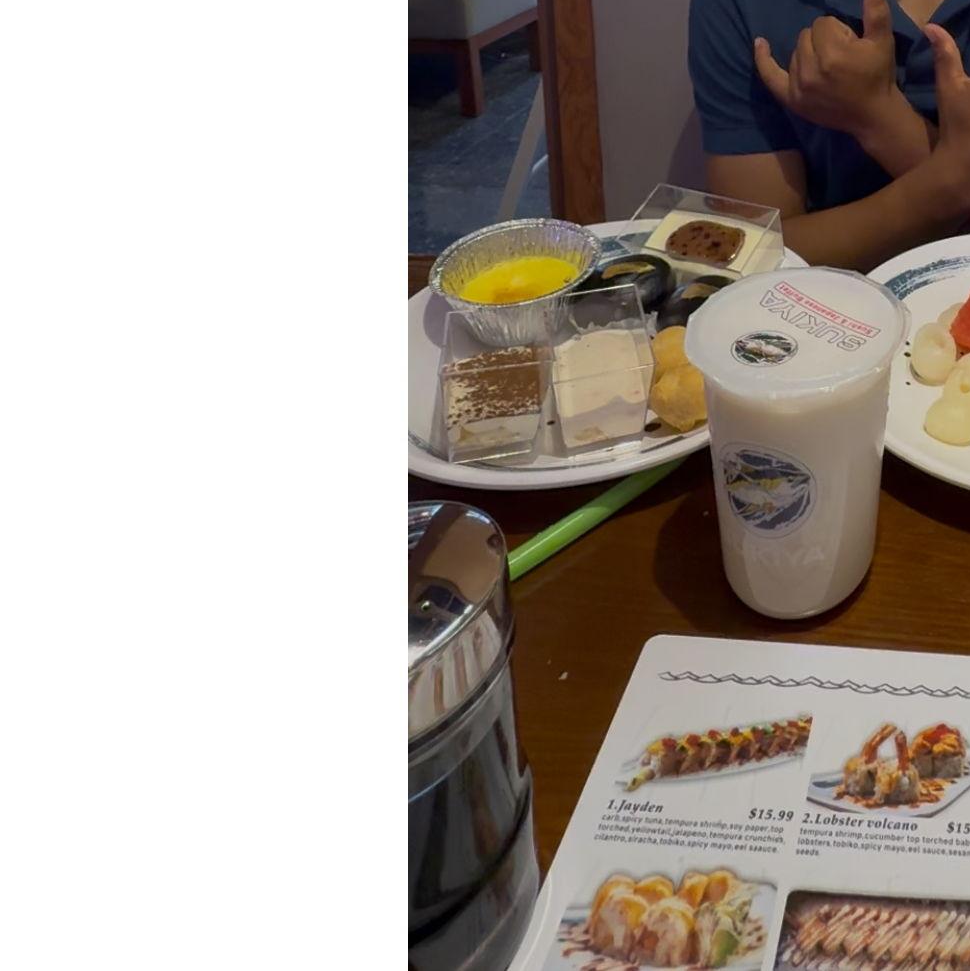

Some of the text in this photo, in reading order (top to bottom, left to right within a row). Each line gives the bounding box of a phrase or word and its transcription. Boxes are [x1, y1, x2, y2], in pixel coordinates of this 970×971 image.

[759, 290, 867, 352] SUKIYA
[607, 799, 663, 814] 1.Jayden
[749, 808, 794, 821] $15.99
[802, 813, 917, 831] 2.Lobster volcano
[800, 827, 832, 837] tempura
[907, 835, 920, 844] top
